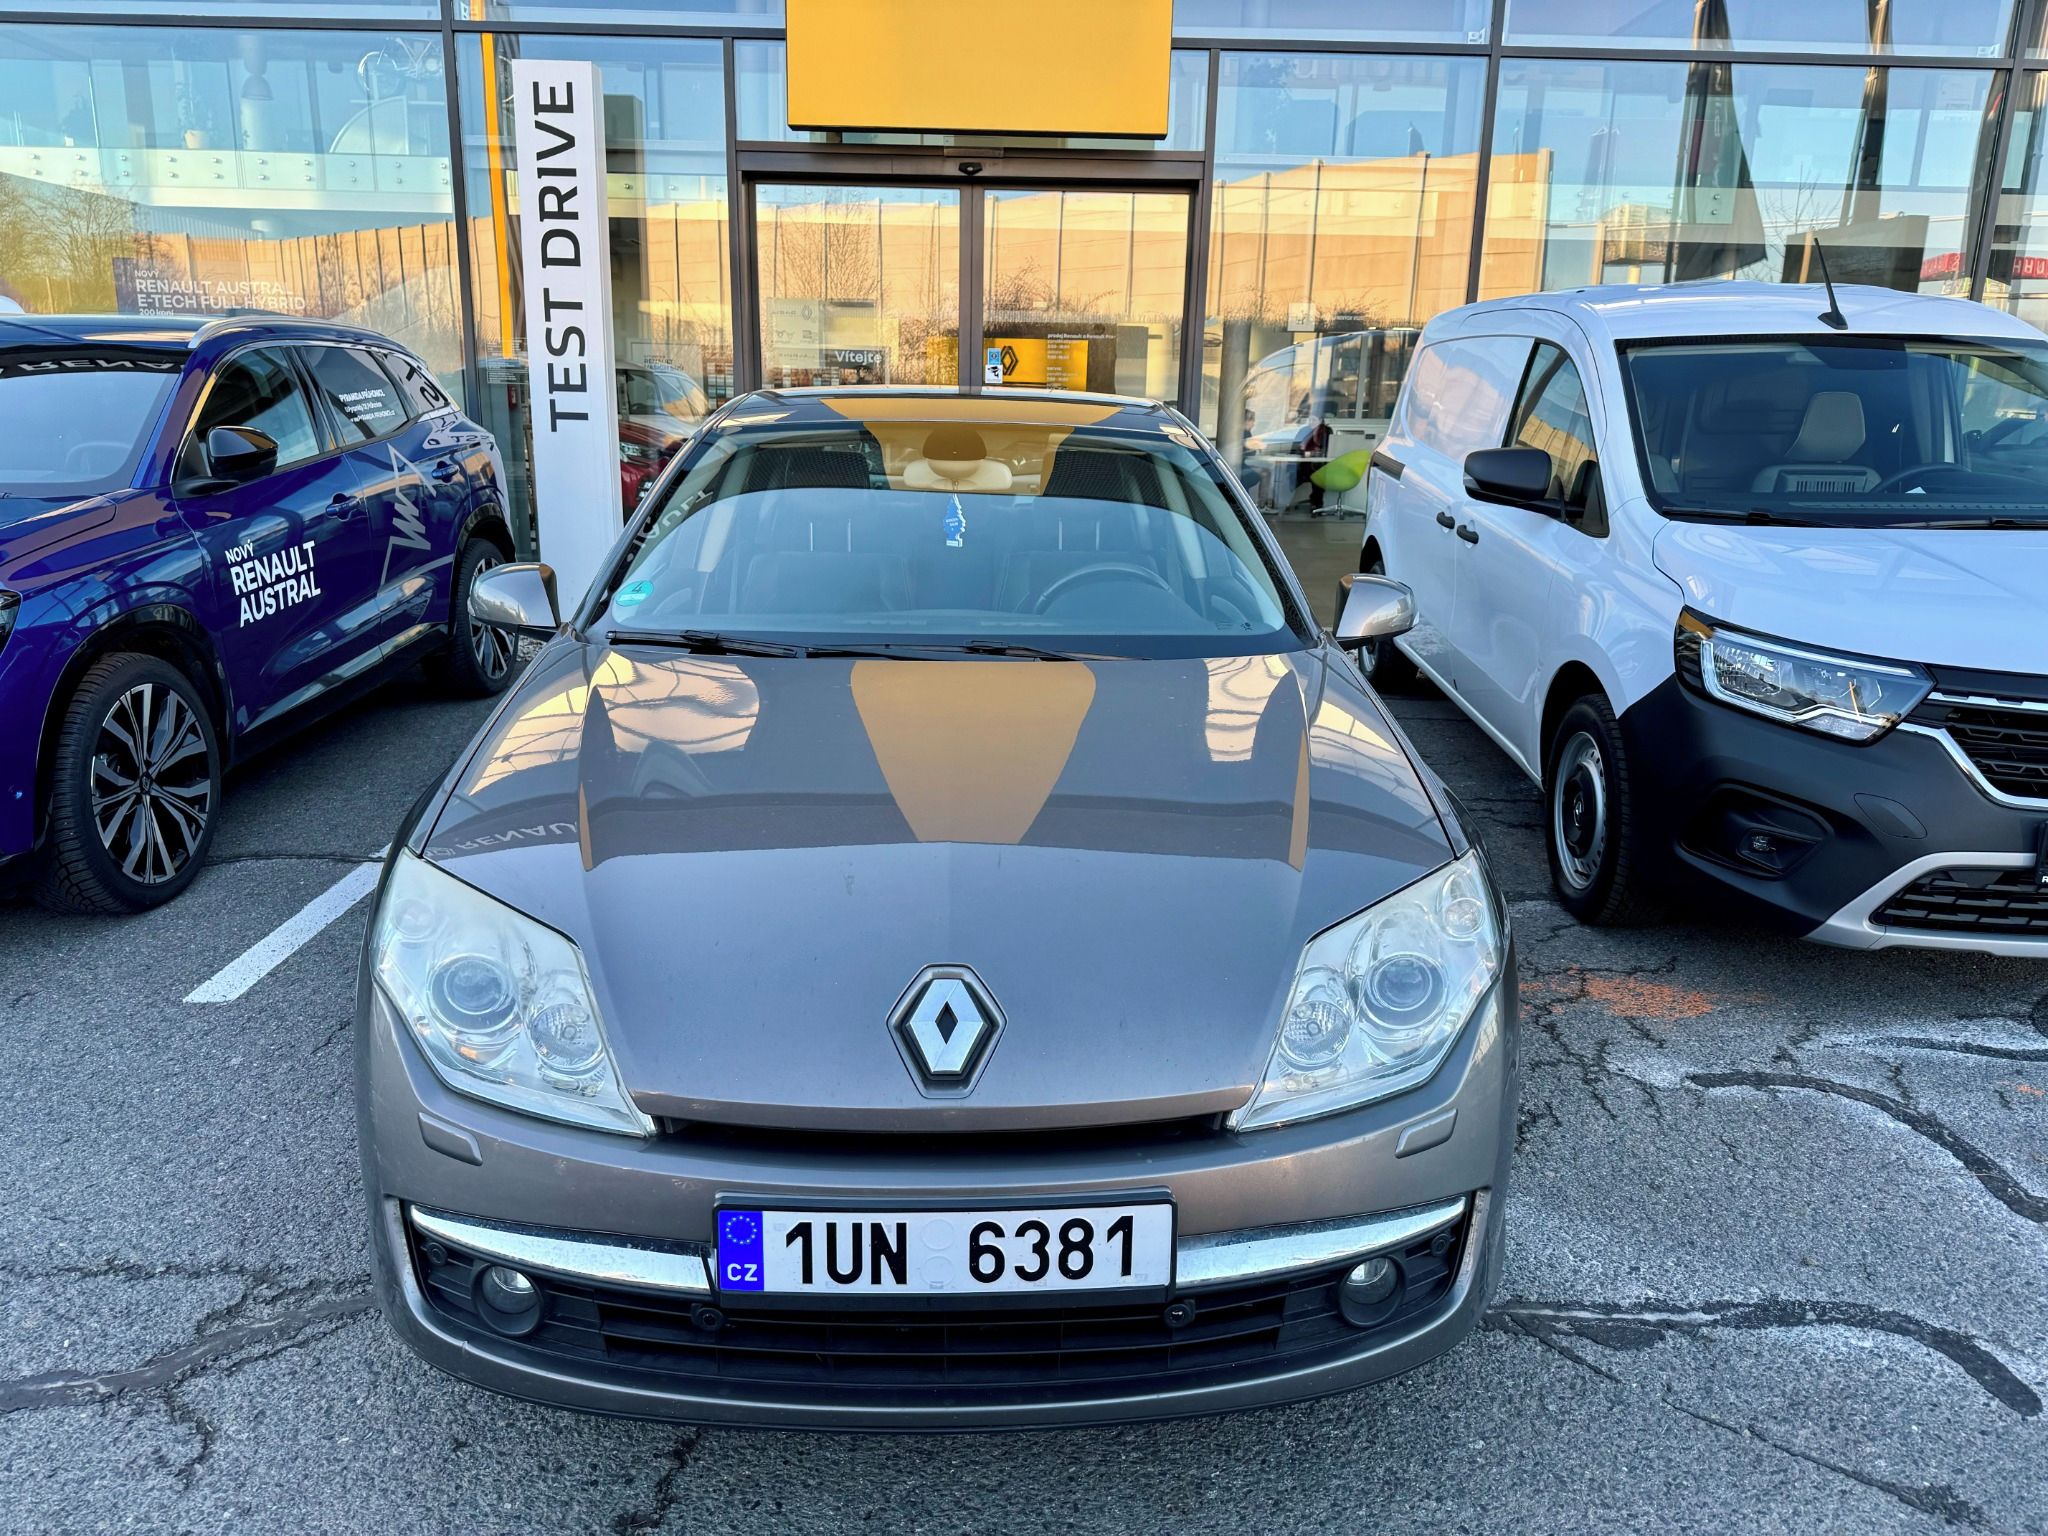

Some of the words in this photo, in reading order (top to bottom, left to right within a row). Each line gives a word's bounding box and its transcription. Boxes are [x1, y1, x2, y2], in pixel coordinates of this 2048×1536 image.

[532, 81, 582, 269] DRIVE
[135, 269, 159, 278] NOVÝ
[136, 280, 212, 294] RENAULT
[216, 281, 294, 295] AUSTRAL
[138, 294, 197, 309] E-TECH
[200, 295, 242, 309] FULL
[244, 296, 306, 310] HYBRID
[543, 288, 589, 432] TEST
[834, 351, 882, 364] Vítejte
[225, 539, 254, 564] NOVÝ
[230, 540, 315, 596] RENAULT
[240, 571, 321, 628] AUSTRAL
[785, 1221, 908, 1285] 1UN
[969, 1215, 1134, 1284] 6381
[727, 1263, 758, 1282] CZ
